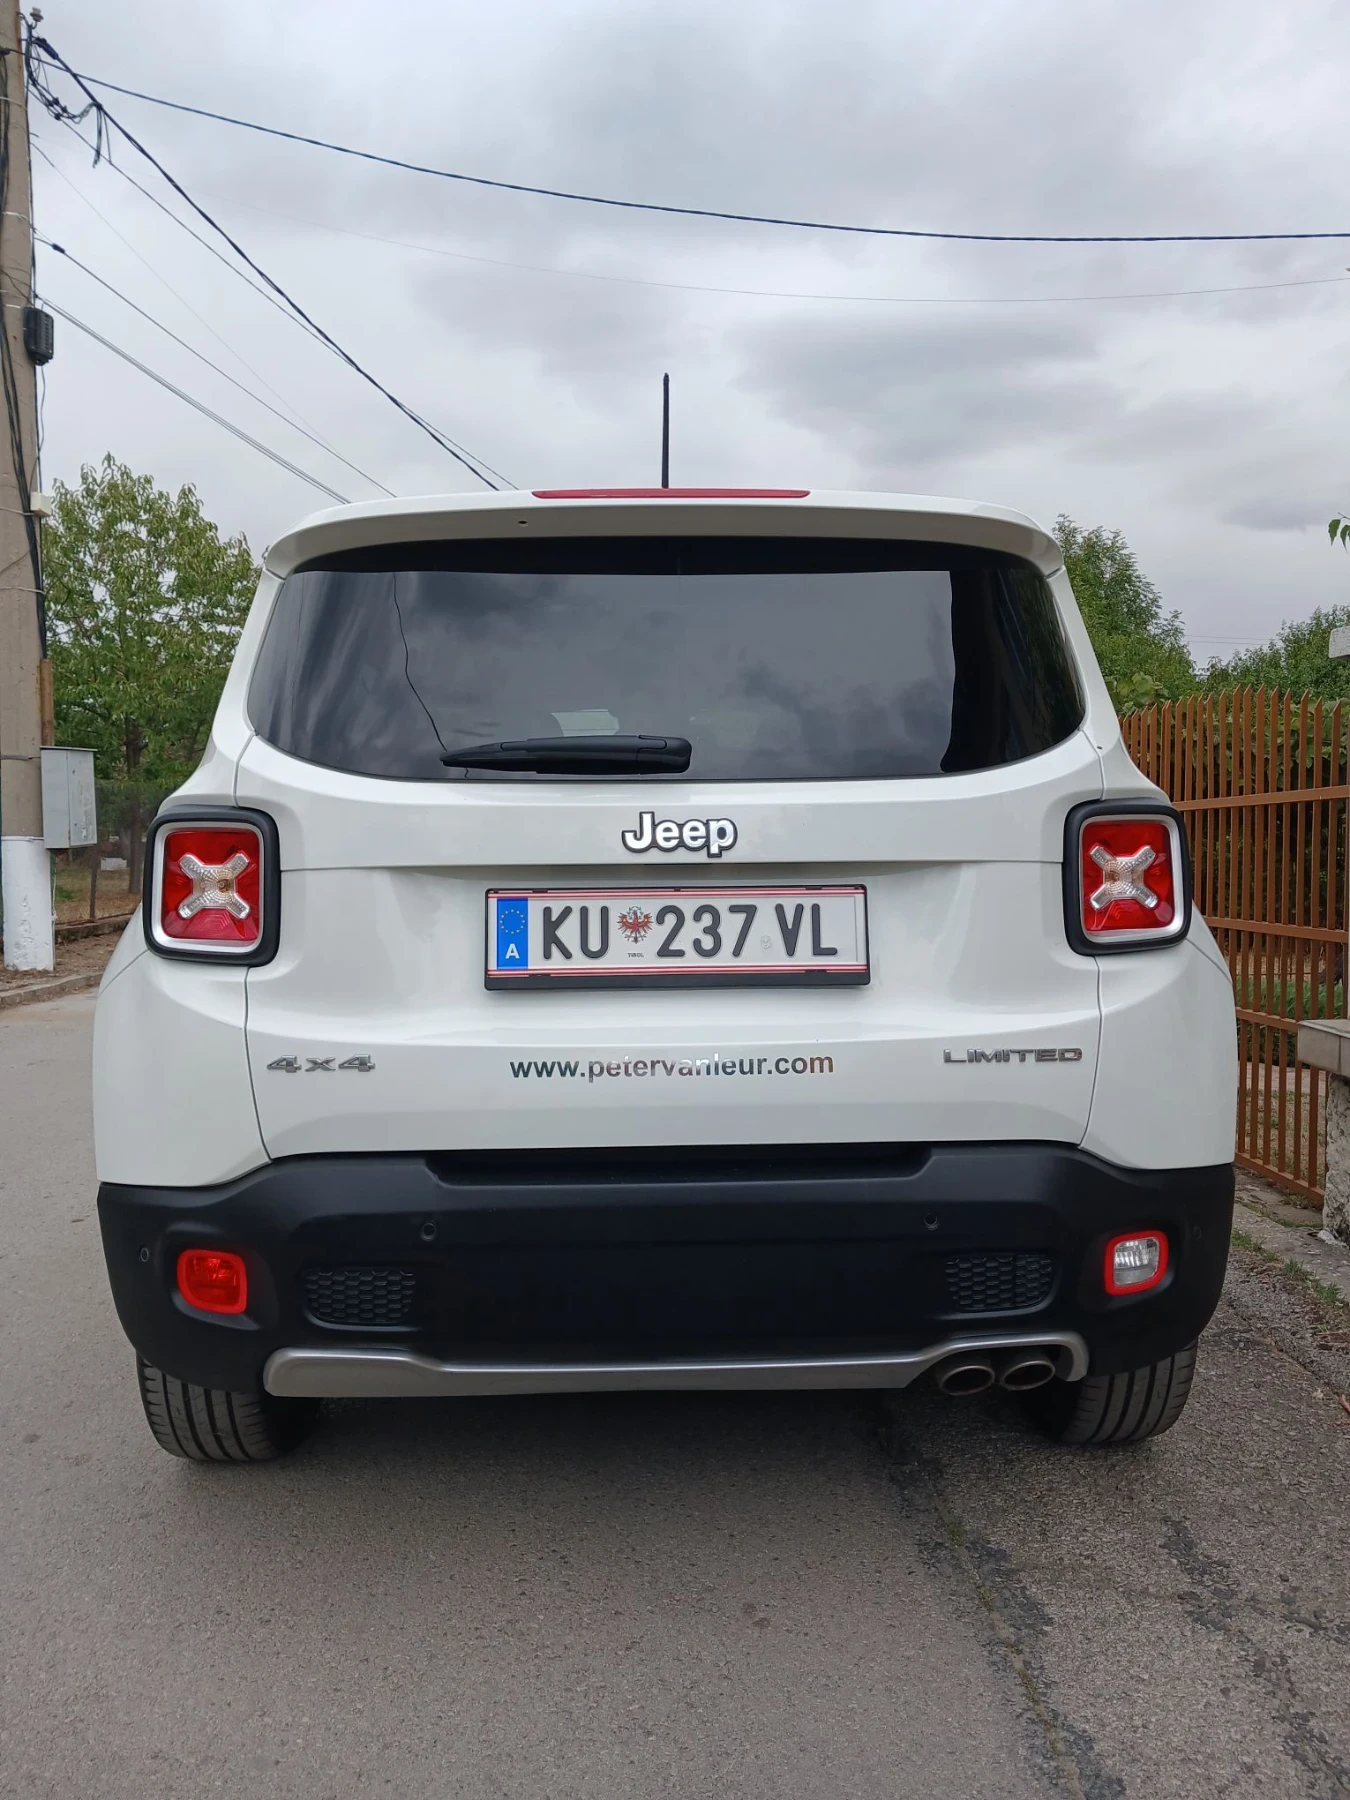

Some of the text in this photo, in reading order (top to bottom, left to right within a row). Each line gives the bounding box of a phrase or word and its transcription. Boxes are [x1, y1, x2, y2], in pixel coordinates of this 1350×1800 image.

[622, 811, 738, 858] Jeep
[542, 902, 838, 960] KU 237 VL
[505, 943, 520, 959] A
[509, 1053, 835, 1084] www.petervanleur.com
[943, 1048, 1083, 1063] LIMITED
